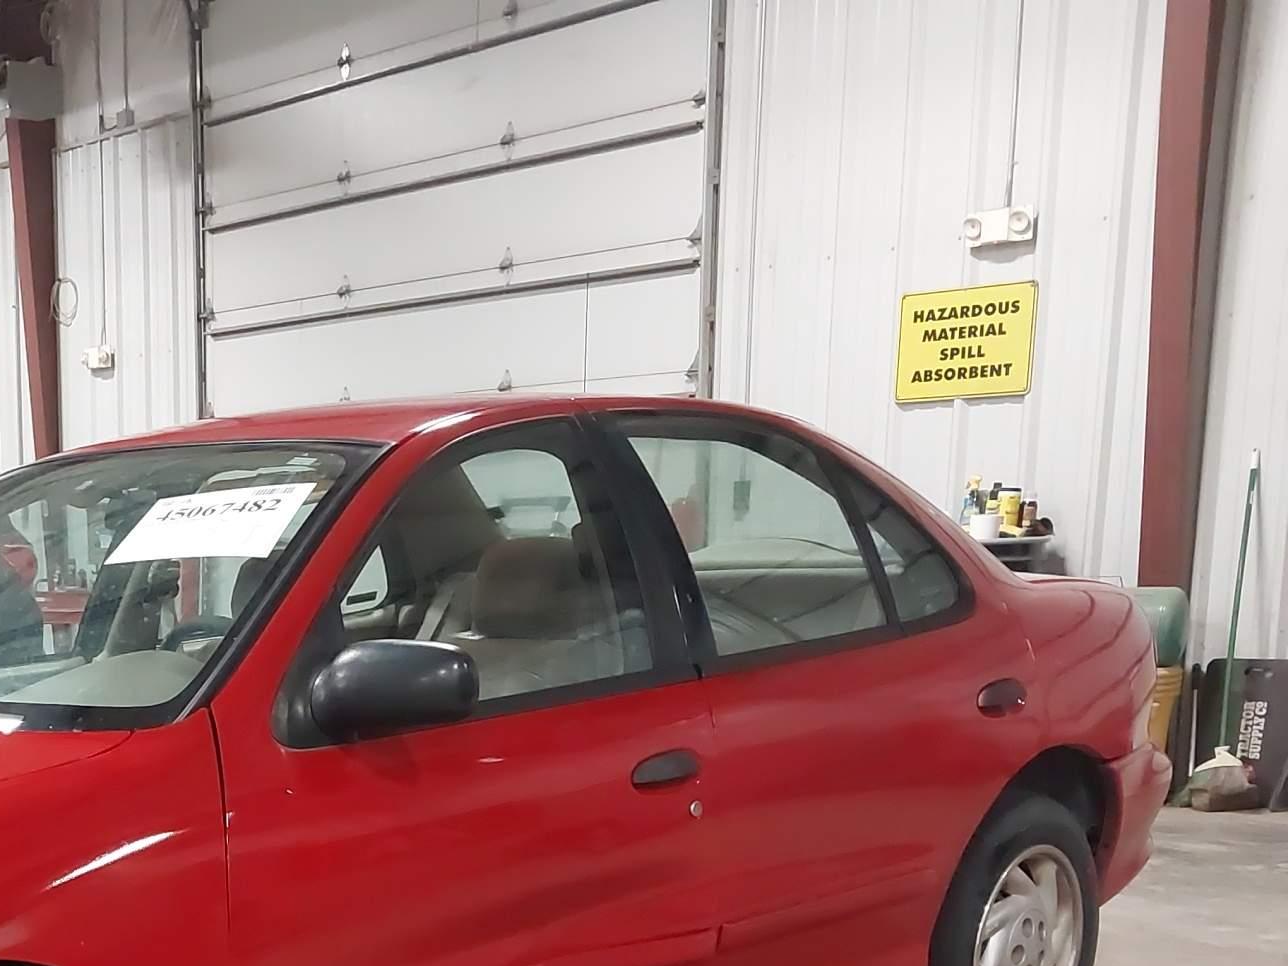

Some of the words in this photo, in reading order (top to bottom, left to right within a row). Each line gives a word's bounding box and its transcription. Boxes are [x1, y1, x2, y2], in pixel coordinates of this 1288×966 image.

[913, 300, 1021, 323] HAZARDOUS
[922, 322, 1007, 343] MATERIAL
[939, 345, 986, 361] SPILL
[911, 363, 1013, 383] ABSORBENT
[156, 498, 282, 522] 45067482
[1248, 716, 1266, 760] SUPPLY
